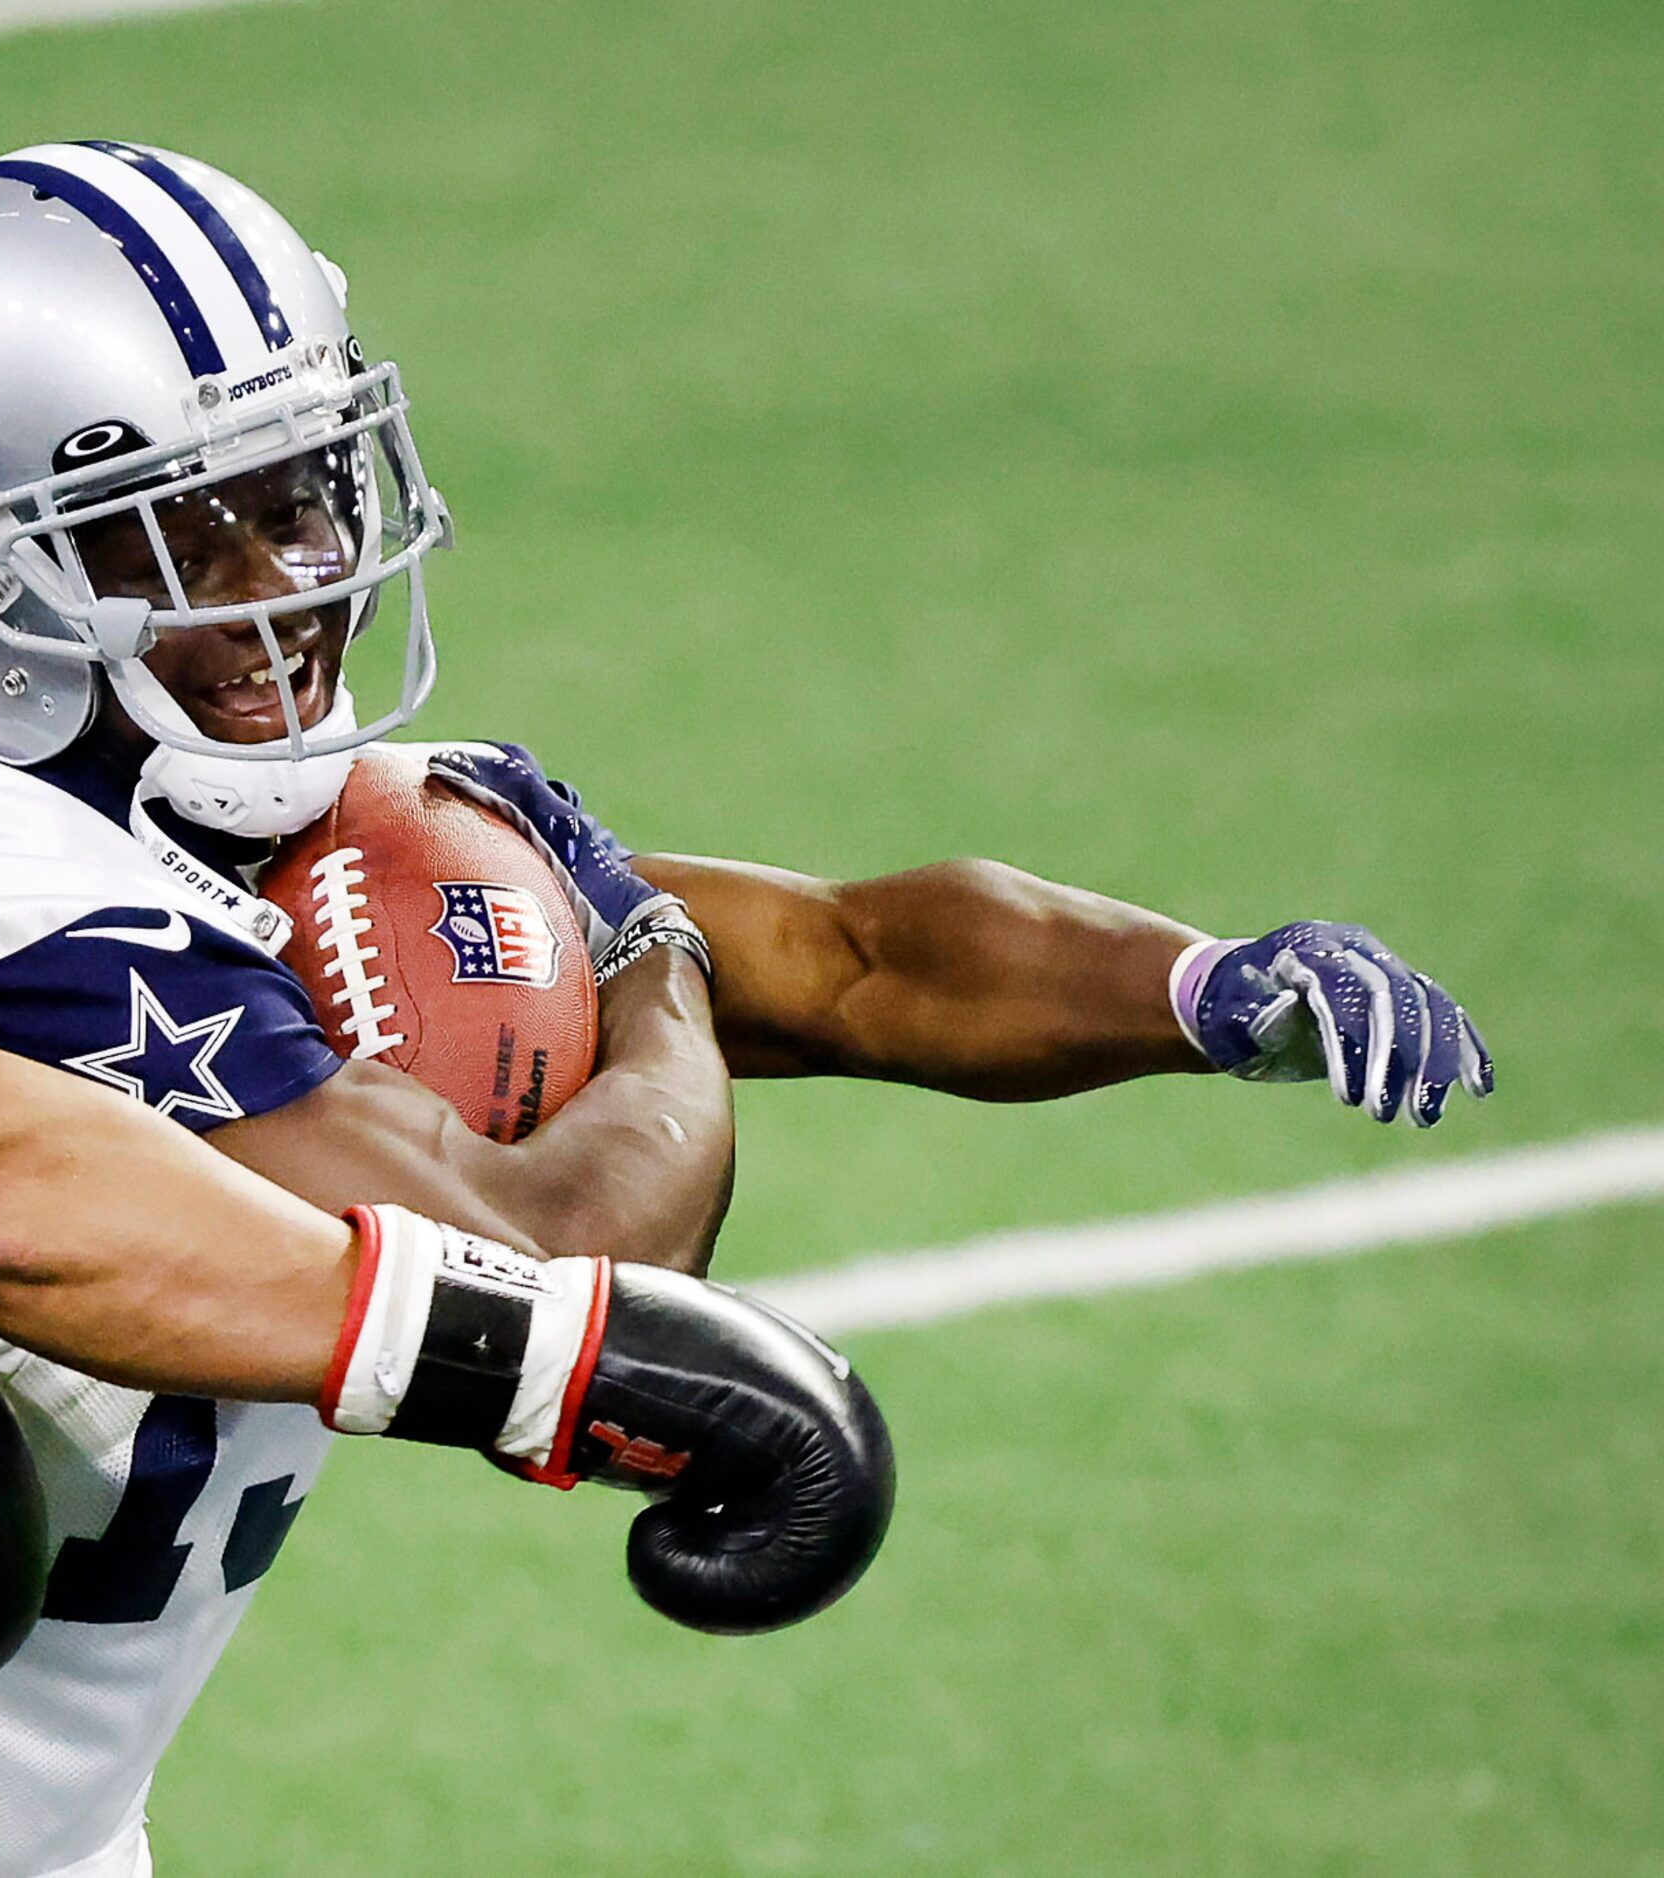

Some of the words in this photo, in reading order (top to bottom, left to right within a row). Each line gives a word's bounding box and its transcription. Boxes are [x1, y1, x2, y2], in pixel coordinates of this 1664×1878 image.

[161, 850, 225, 900] SPORT
[490, 897, 549, 973] NFL
[593, 936, 653, 987] OMANS
